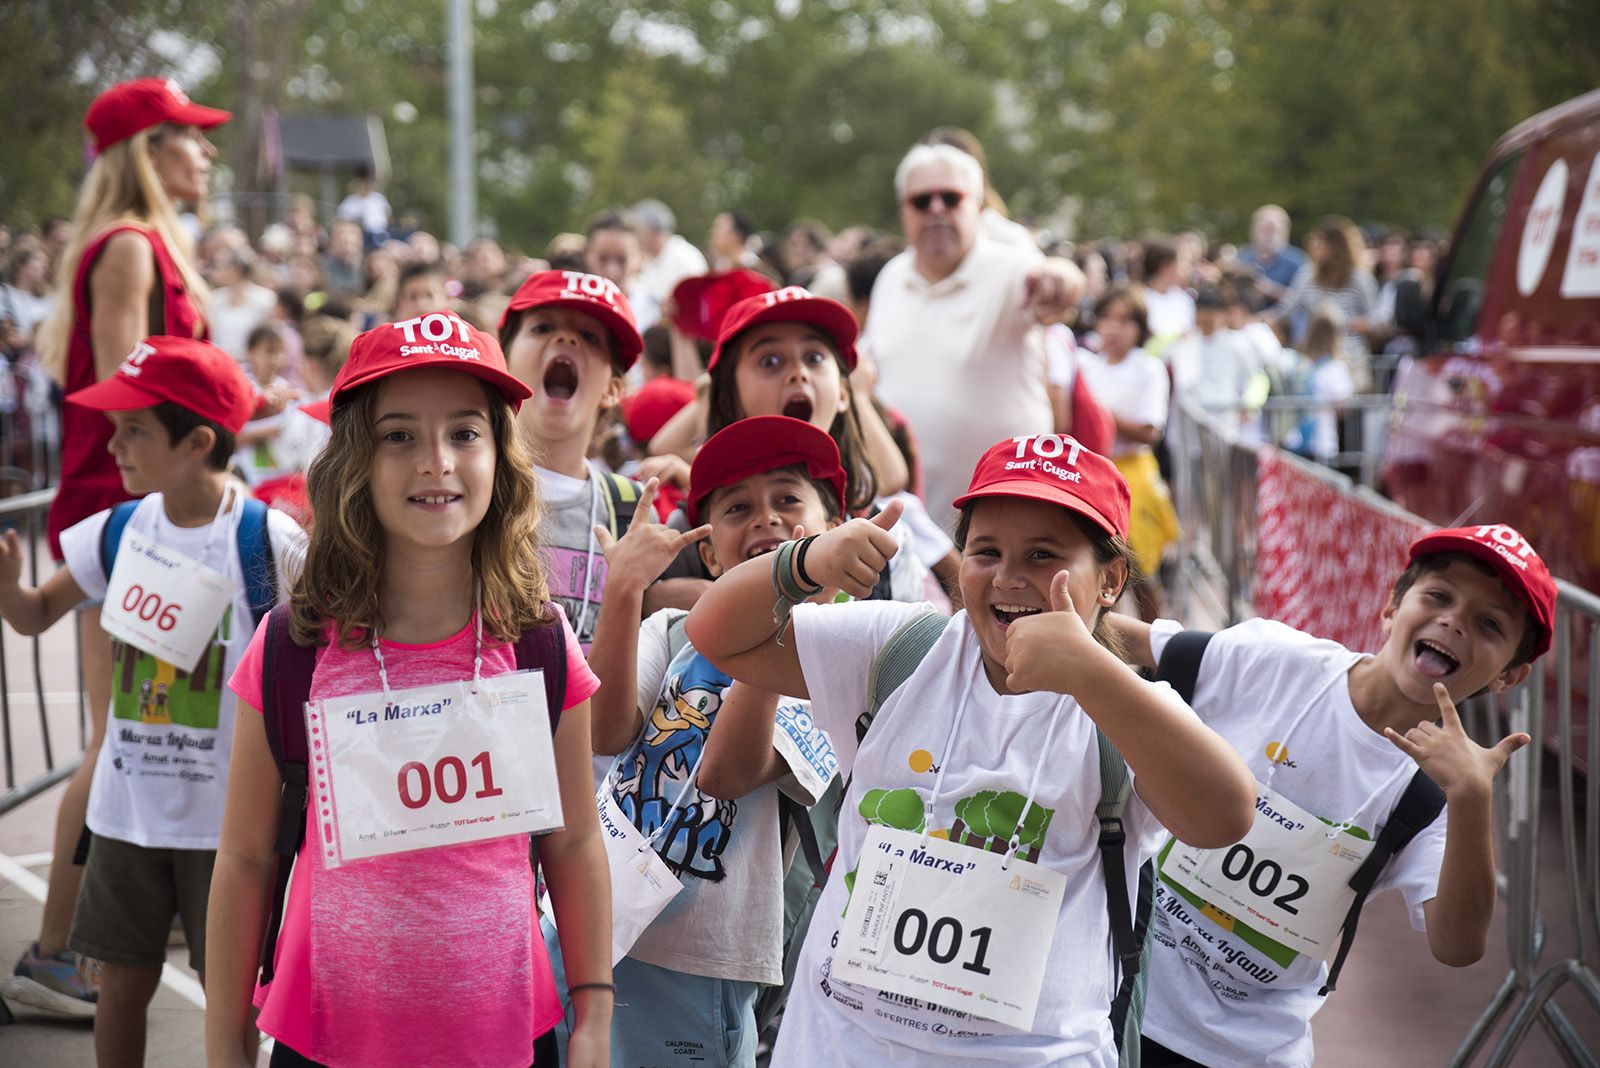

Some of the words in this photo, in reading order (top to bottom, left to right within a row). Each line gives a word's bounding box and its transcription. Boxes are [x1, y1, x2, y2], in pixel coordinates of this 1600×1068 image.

[562, 270, 620, 304] TOT
[393, 313, 470, 343] TOT
[400, 344, 434, 356] Sant
[440, 343, 480, 360] Cugat
[1013, 434, 1088, 466] TOT
[1005, 459, 1036, 470] Sant
[1042, 461, 1081, 483] Cugat
[1474, 525, 1537, 558] TOT
[122, 584, 182, 631] 006
[346, 711, 378, 725] “La
[384, 699, 452, 722] Marxa”
[777, 704, 839, 774] SONIC
[396, 751, 503, 809] 001
[1256, 797, 1304, 831] Marxa”
[909, 848, 976, 875] Marxa”
[1221, 843, 1309, 915] 002
[893, 907, 992, 976] 001
[1163, 896, 1214, 943] Marxa
[1216, 939, 1278, 984] Infantil
[1181, 935, 1211, 967] Amat.
[884, 1012, 928, 1031] FERTRES
[665, 1040, 704, 1049] CALIFORNIA
